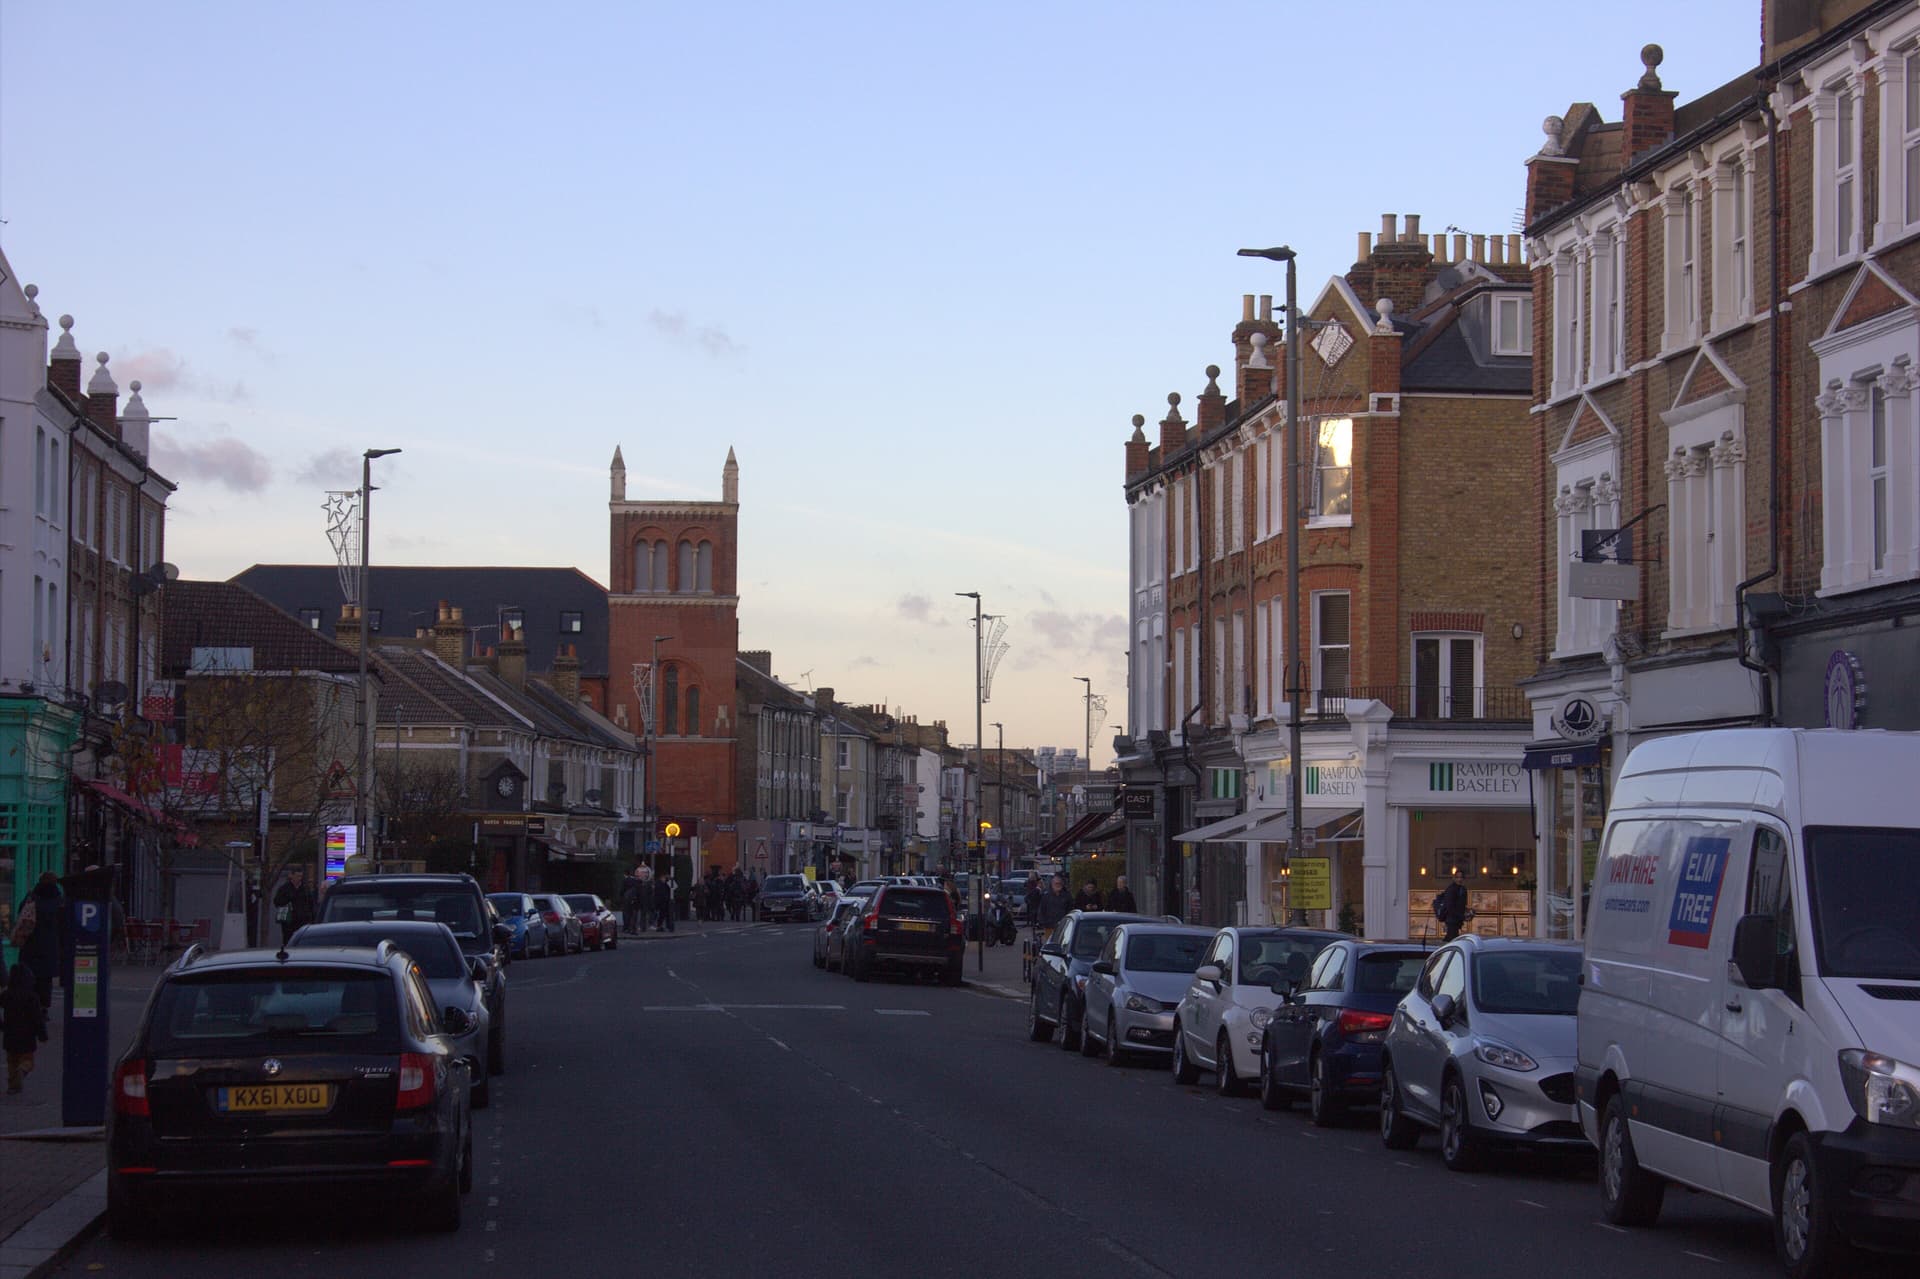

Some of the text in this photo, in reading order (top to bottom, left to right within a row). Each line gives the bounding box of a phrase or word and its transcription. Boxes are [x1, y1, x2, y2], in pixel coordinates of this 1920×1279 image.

[1320, 782, 1355, 795] BASELEY
[1456, 779, 1520, 792] BASELEY
[1126, 795, 1153, 803] CAST
[1610, 855, 1633, 884] VAN
[1630, 855, 1660, 885] HIRE
[1686, 853, 1717, 883] ELM
[82, 904, 97, 927] P
[1677, 893, 1713, 924] TREE
[235, 1088, 278, 1106] KX61
